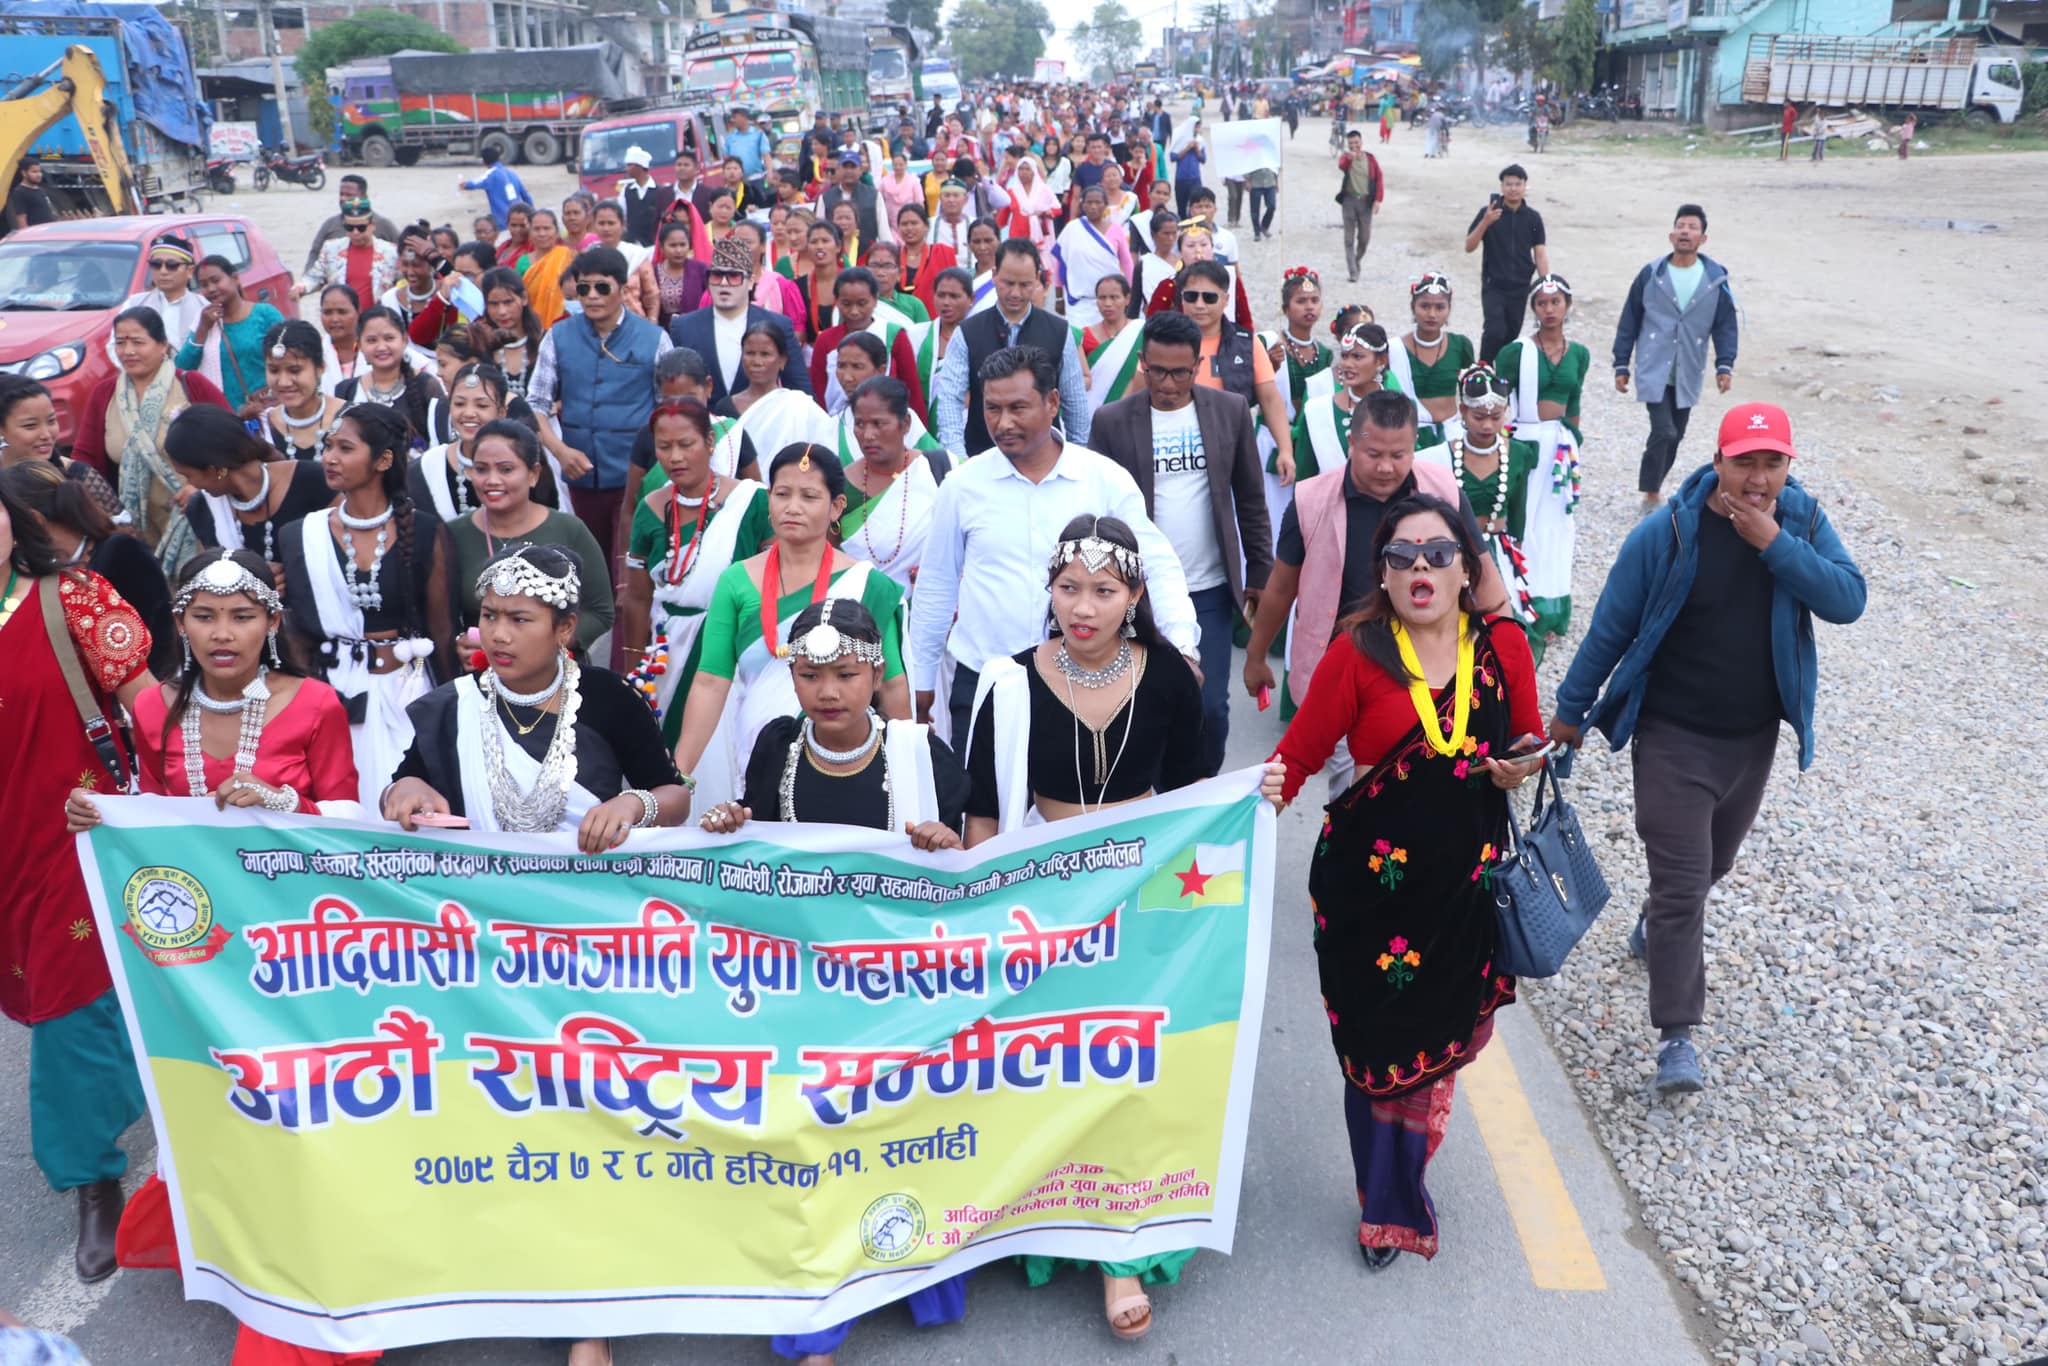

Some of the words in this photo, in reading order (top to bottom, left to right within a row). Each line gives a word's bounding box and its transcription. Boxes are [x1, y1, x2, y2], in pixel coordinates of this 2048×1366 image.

[646, 855, 703, 882] अभियान
[720, 860, 773, 894] समावेशी,
[777, 864, 834, 895] रोजगारी
[837, 875, 849, 893] र
[850, 874, 876, 897] युवा
[880, 875, 966, 902] सहभागिताको
[969, 871, 1001, 898] लागी
[1039, 853, 1081, 878] राष्ट्रिय
[142, 930, 168, 945] YFIN
[171, 927, 200, 945] Nepal
[246, 897, 478, 995] आदिवासी
[491, 897, 697, 994] जनजाति
[708, 923, 801, 1012] युवा
[810, 924, 989, 1001] महासंघ
[469, 1015, 774, 1140] राष्ट्रिय
[414, 1155, 496, 1184] २०७९
[507, 1143, 559, 1182] चैत्र
[569, 1151, 590, 1179] ७
[602, 1149, 625, 1182] र
[635, 1150, 653, 1178] ८
[666, 1147, 714, 1182] गते
[880, 1122, 979, 1168] सर्लाही
[1070, 1179, 1098, 1193] युवा
[1160, 1168, 1196, 1187] नेपाल
[1167, 1181, 1210, 1200] समिति
